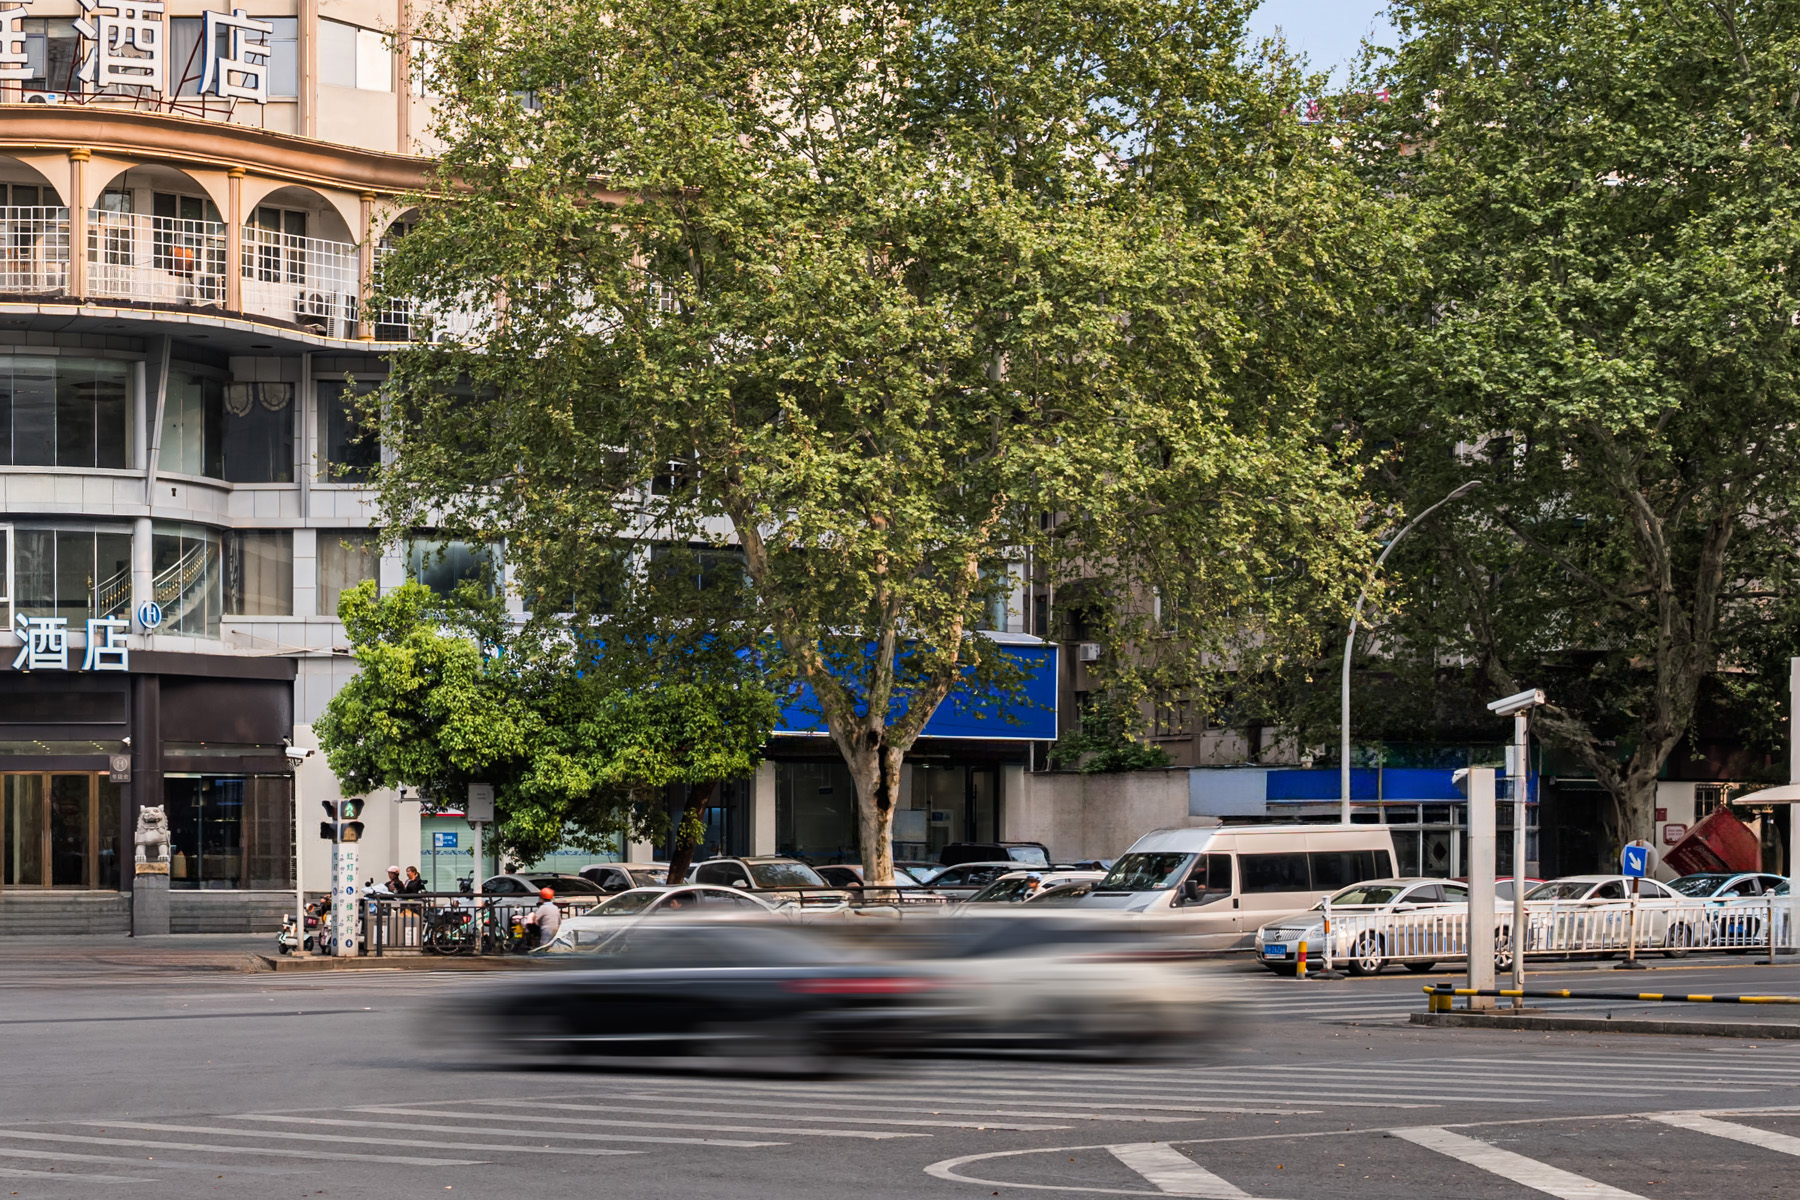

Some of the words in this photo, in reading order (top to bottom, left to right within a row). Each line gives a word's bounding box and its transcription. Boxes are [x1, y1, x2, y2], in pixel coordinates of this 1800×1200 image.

[346, 852, 354, 882] 红灯停
[346, 902, 354, 935] 绿灯行
